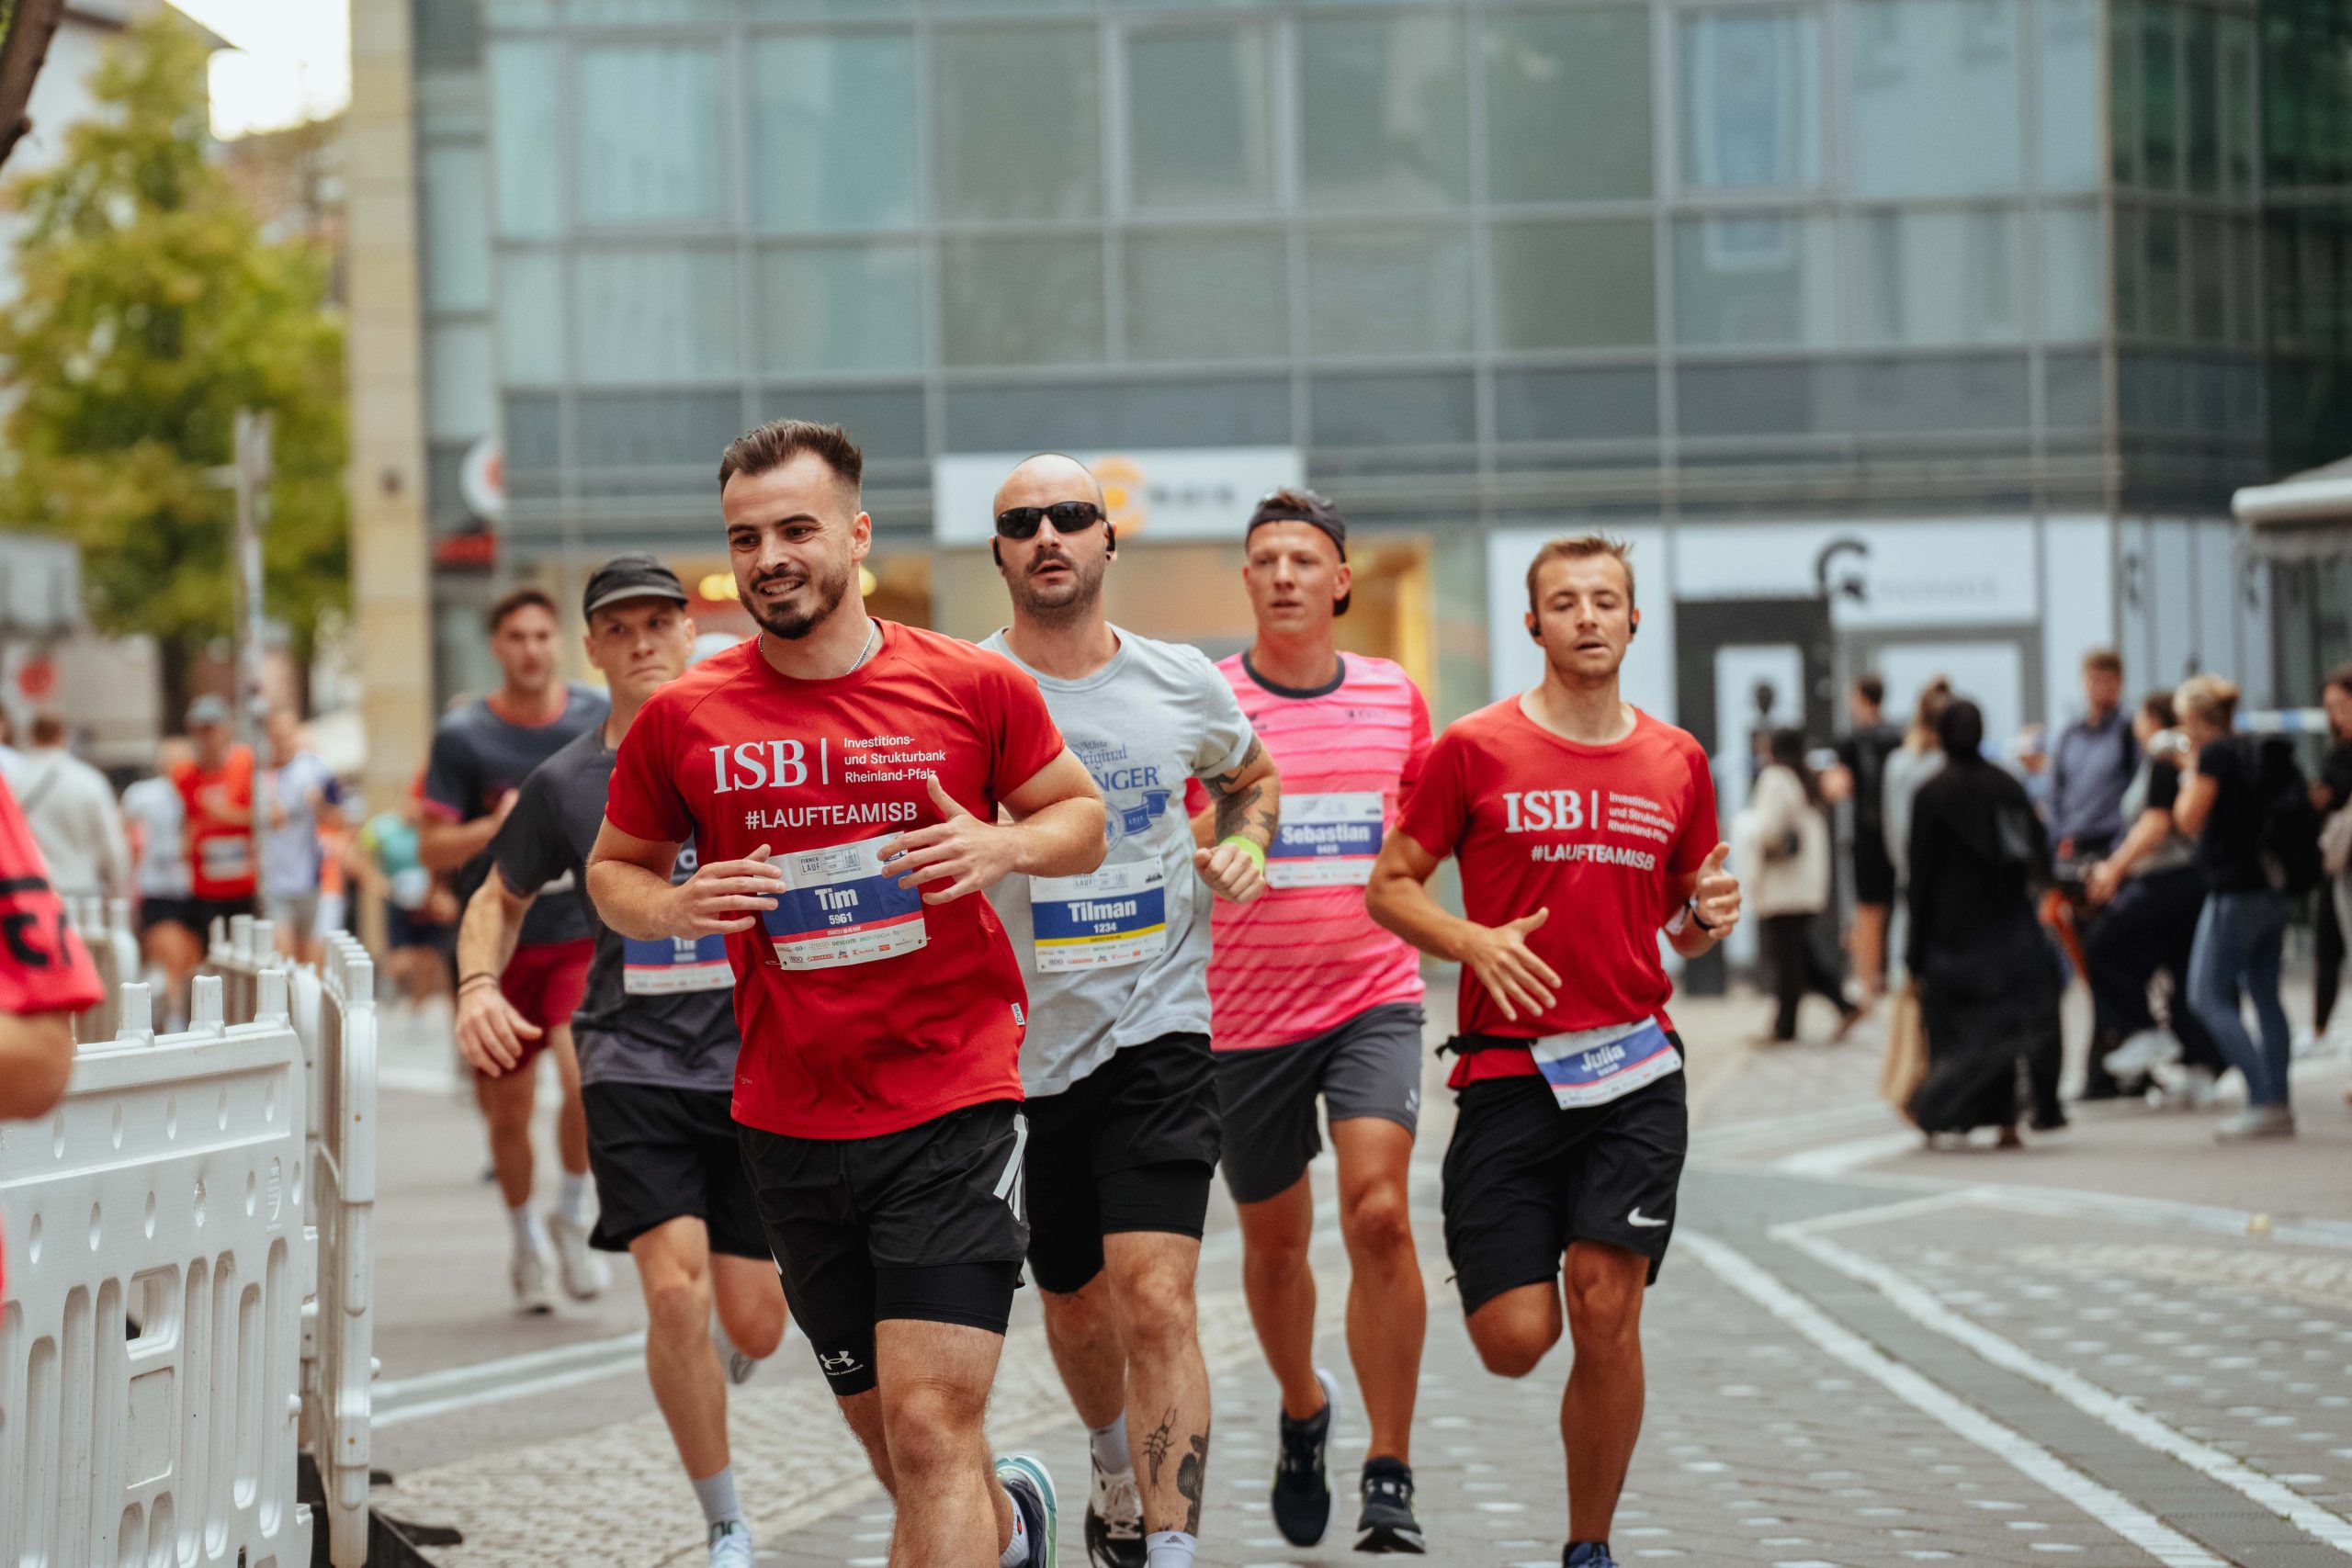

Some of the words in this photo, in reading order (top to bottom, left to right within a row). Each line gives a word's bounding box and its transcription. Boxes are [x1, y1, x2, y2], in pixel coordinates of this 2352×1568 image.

[843, 735, 915, 749] Investitions-
[709, 739, 808, 794] ISB
[844, 754, 866, 765] und
[870, 751, 945, 764] Strukturbank
[745, 801, 918, 829] #LAUFTEAMISB
[1502, 790, 1583, 833] ISB
[802, 863, 820, 873] LAUF
[1532, 843, 1657, 872] #LAUFTEAMISB
[815, 887, 859, 911] Tim
[1068, 899, 1137, 923] Tilman
[829, 912, 853, 925] 5961
[1093, 922, 1117, 934] 1234
